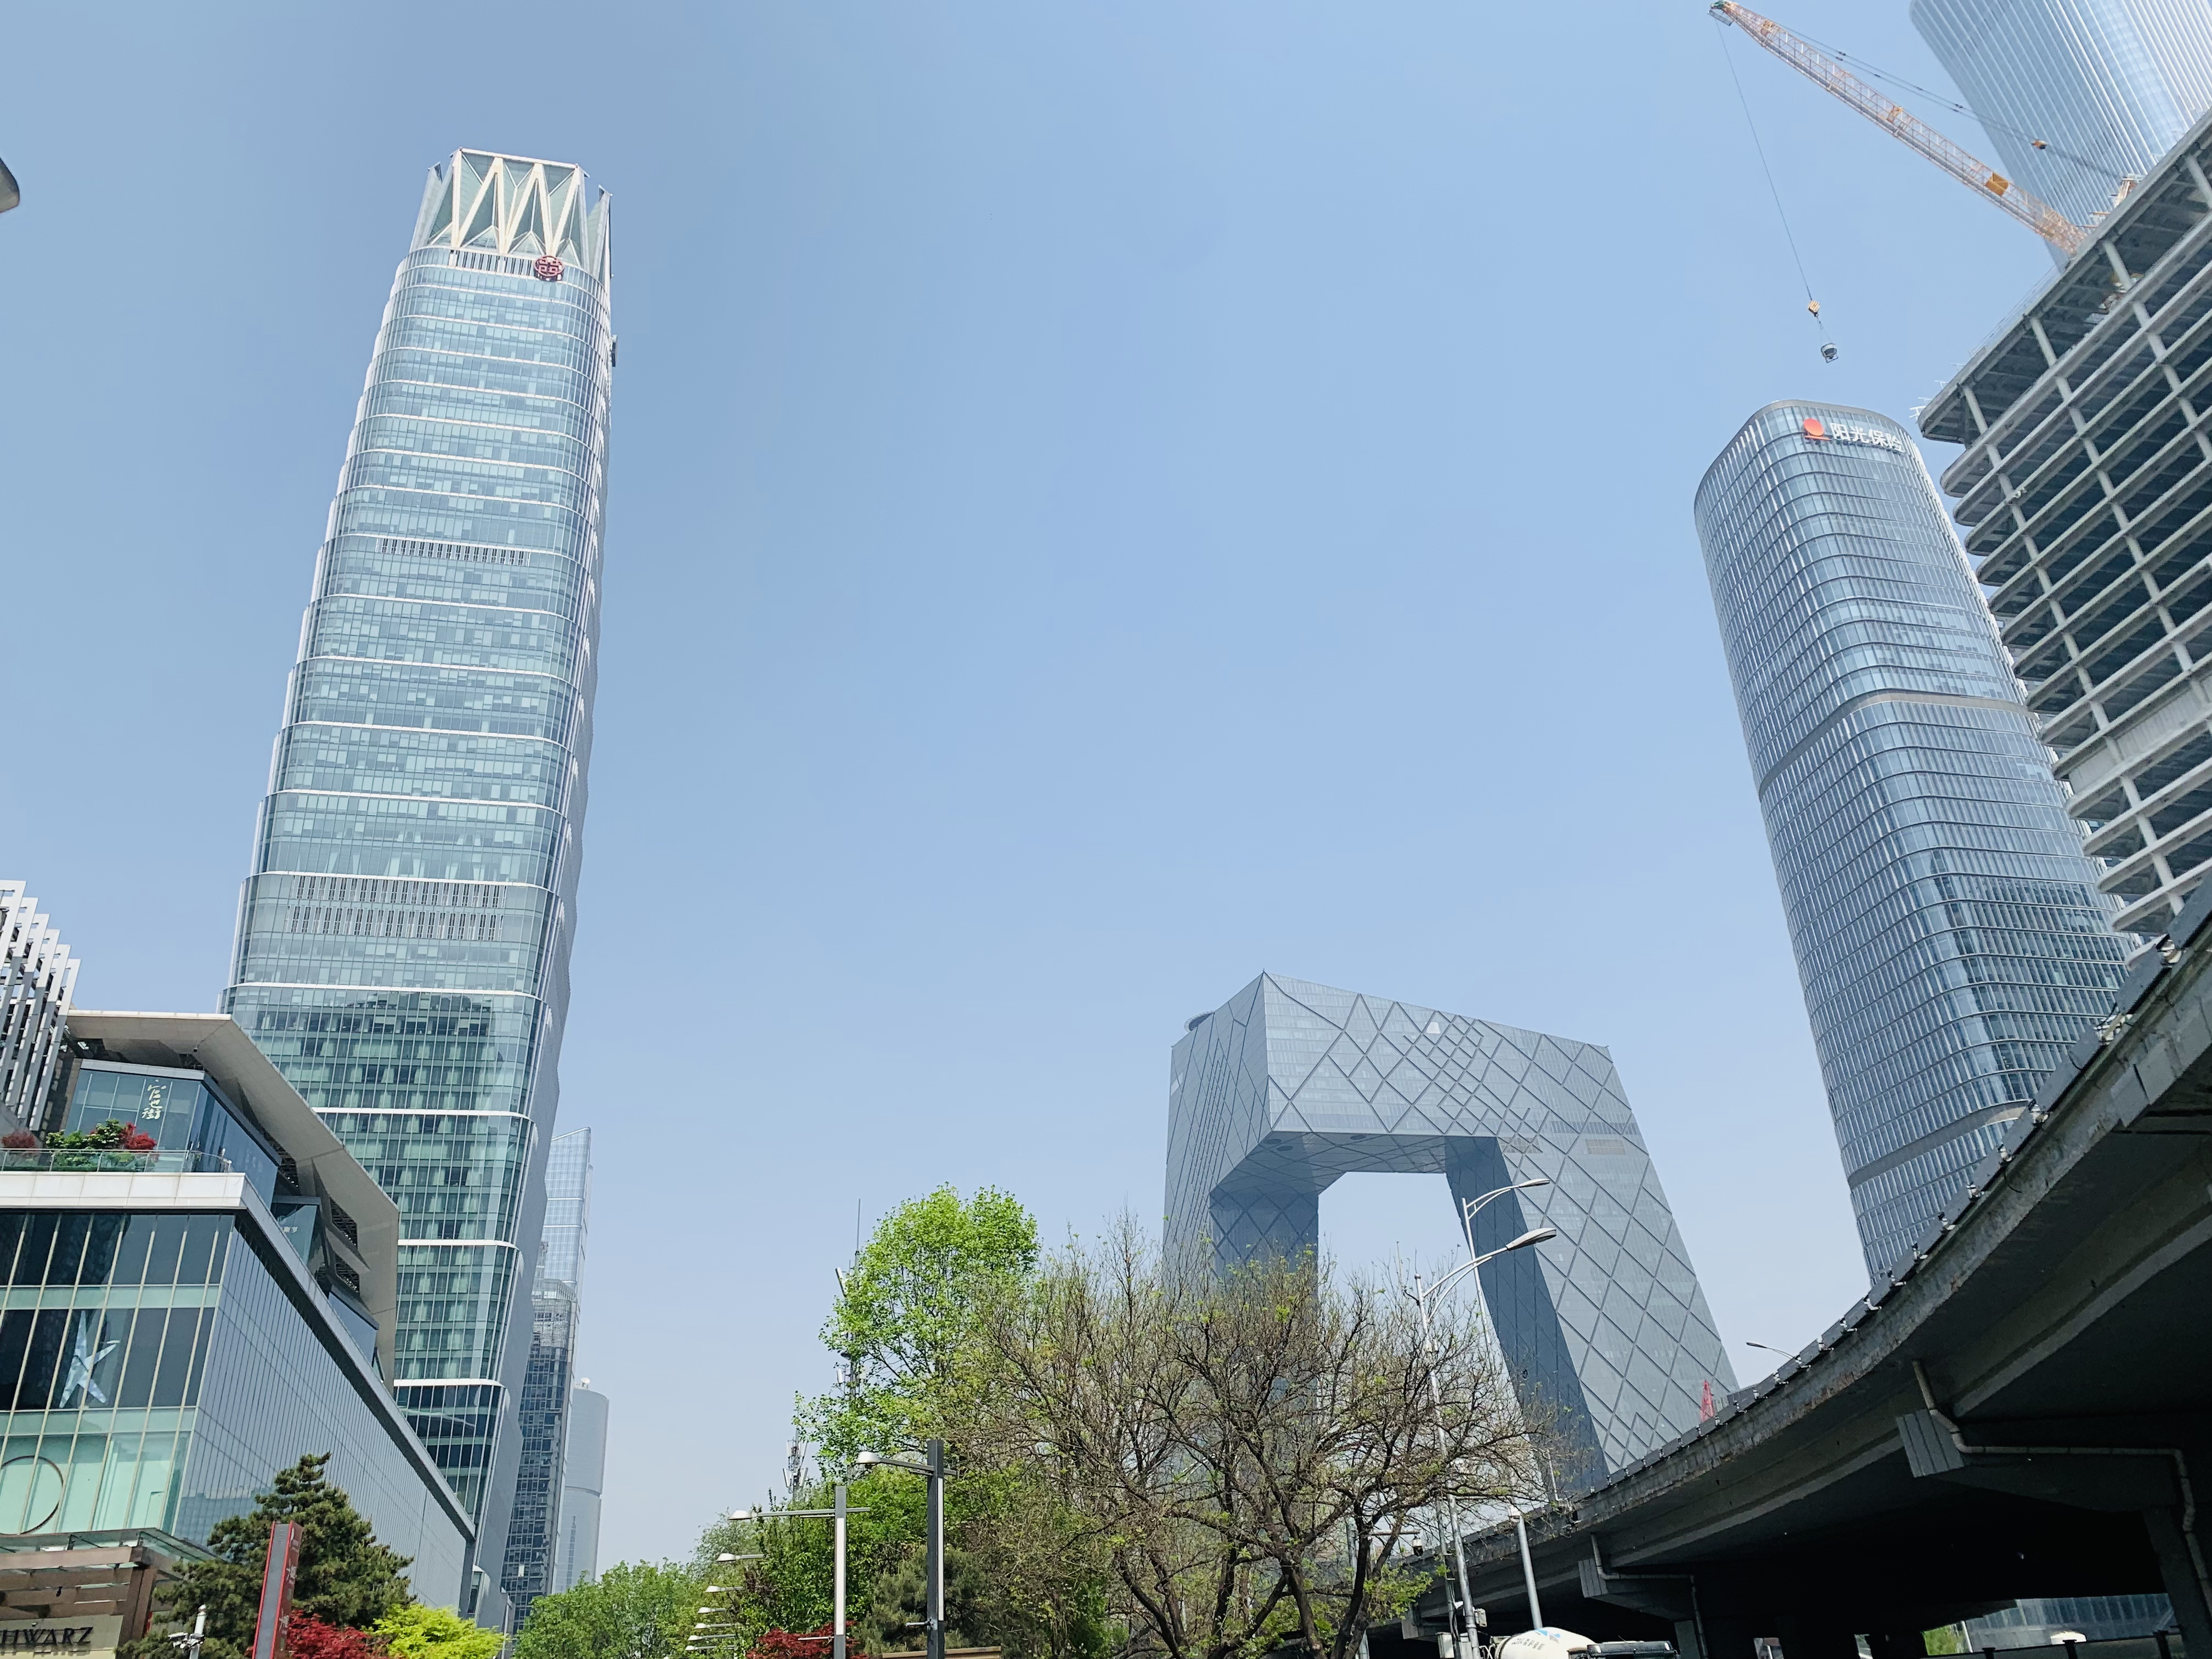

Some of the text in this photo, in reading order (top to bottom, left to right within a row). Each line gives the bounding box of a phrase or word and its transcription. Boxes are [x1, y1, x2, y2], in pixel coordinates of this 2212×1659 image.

[1830, 422, 1905, 453] 阳光保险
[142, 1079, 167, 1120] 官也街
